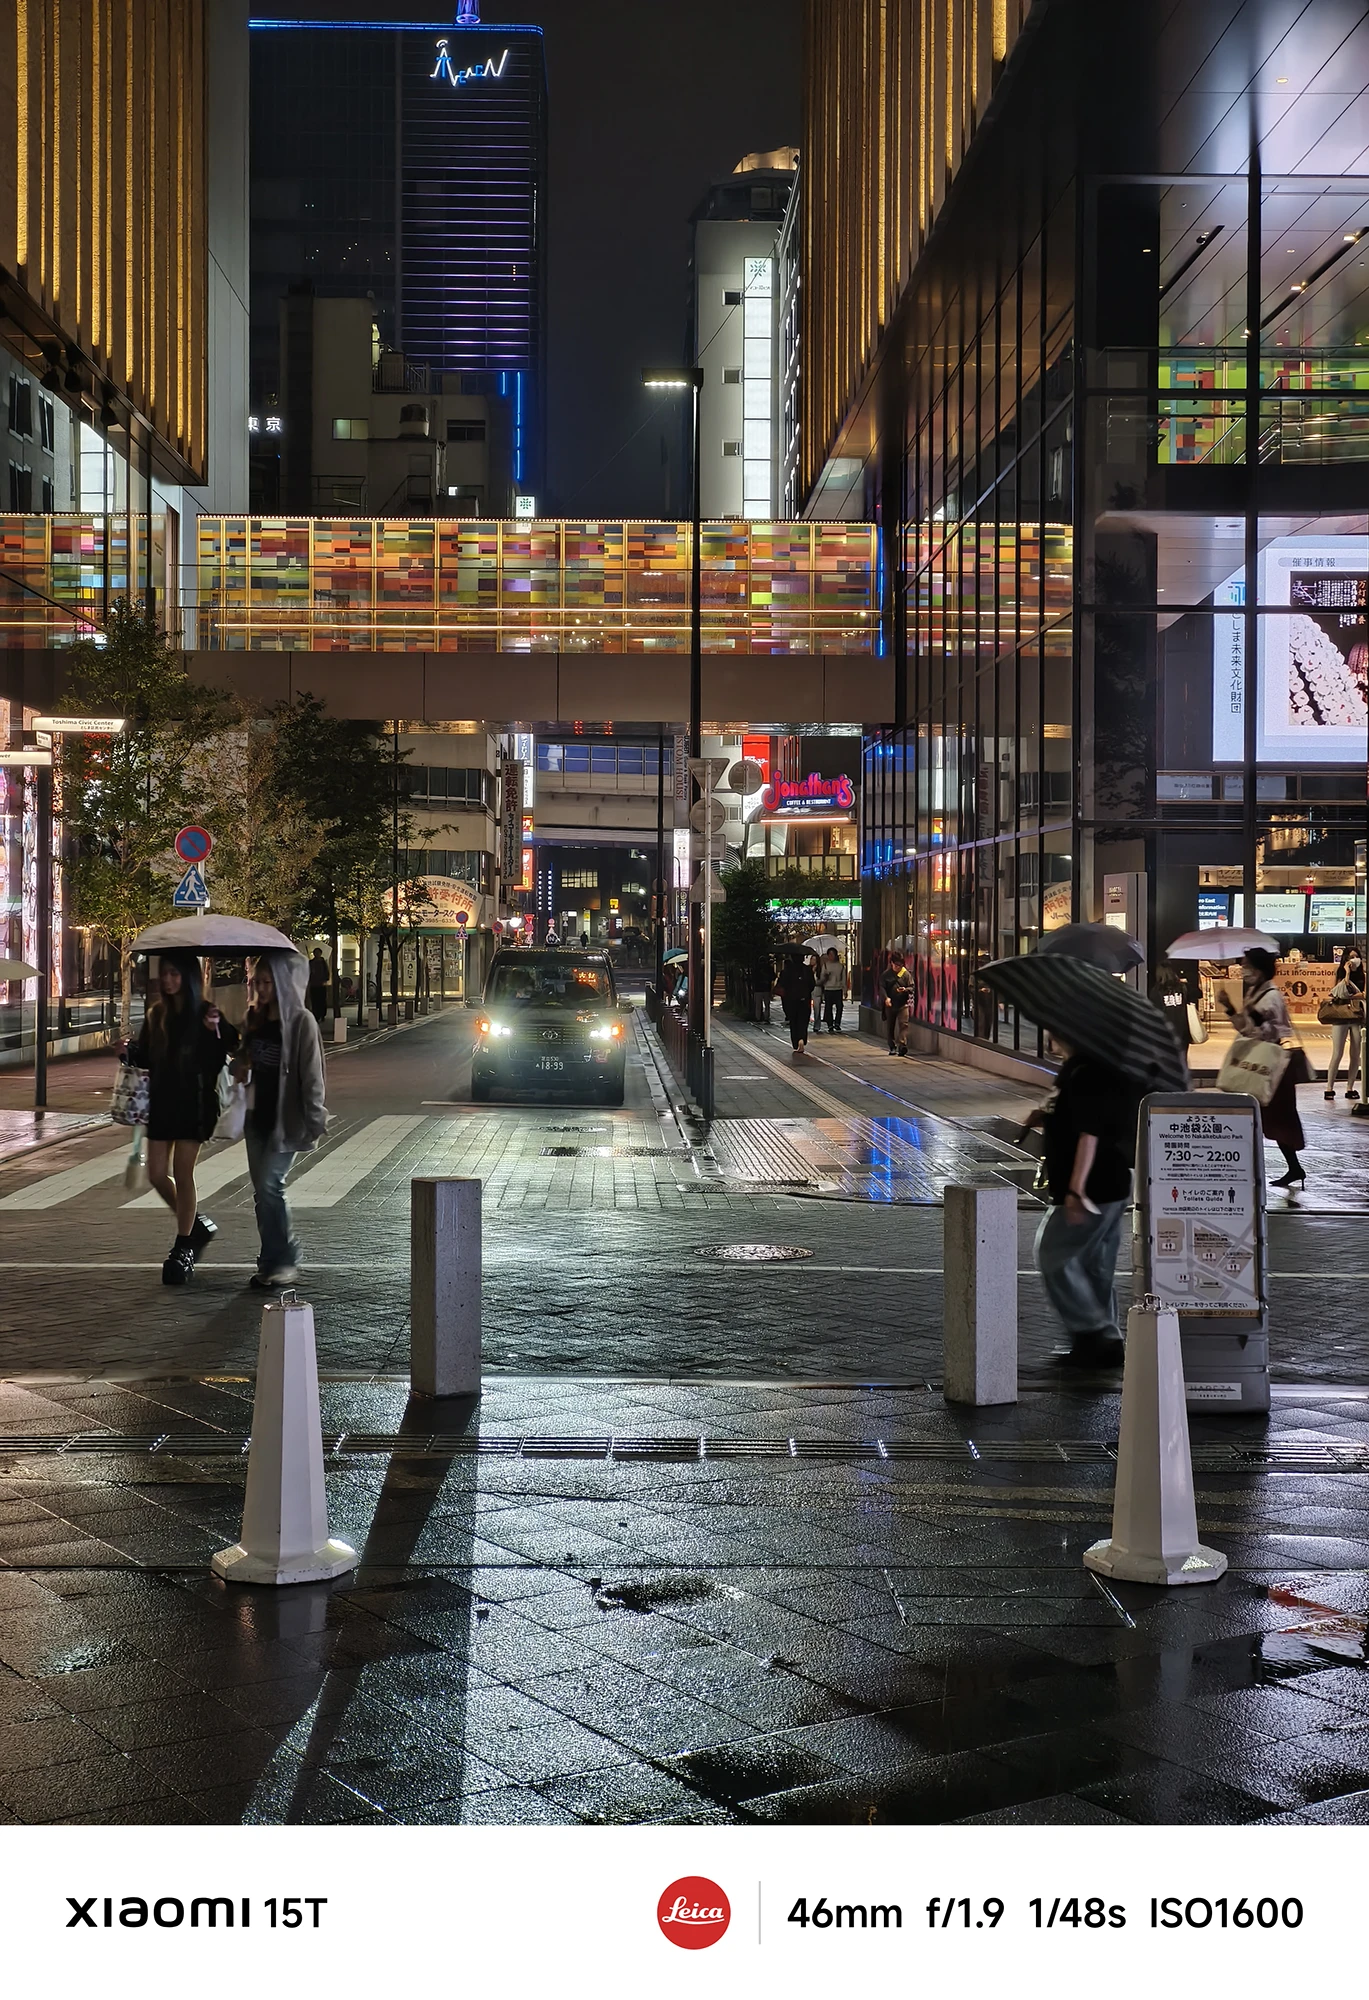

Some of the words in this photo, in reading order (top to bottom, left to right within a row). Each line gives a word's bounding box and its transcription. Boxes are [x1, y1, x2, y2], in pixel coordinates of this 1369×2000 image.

[1292, 557, 1336, 568] 催事情報
[505, 764, 519, 812] 運転免許
[541, 1061, 564, 1070] 18-99
[1186, 1115, 1217, 1123] ようこそ
[1169, 1123, 1233, 1134] 中池袋公園へ
